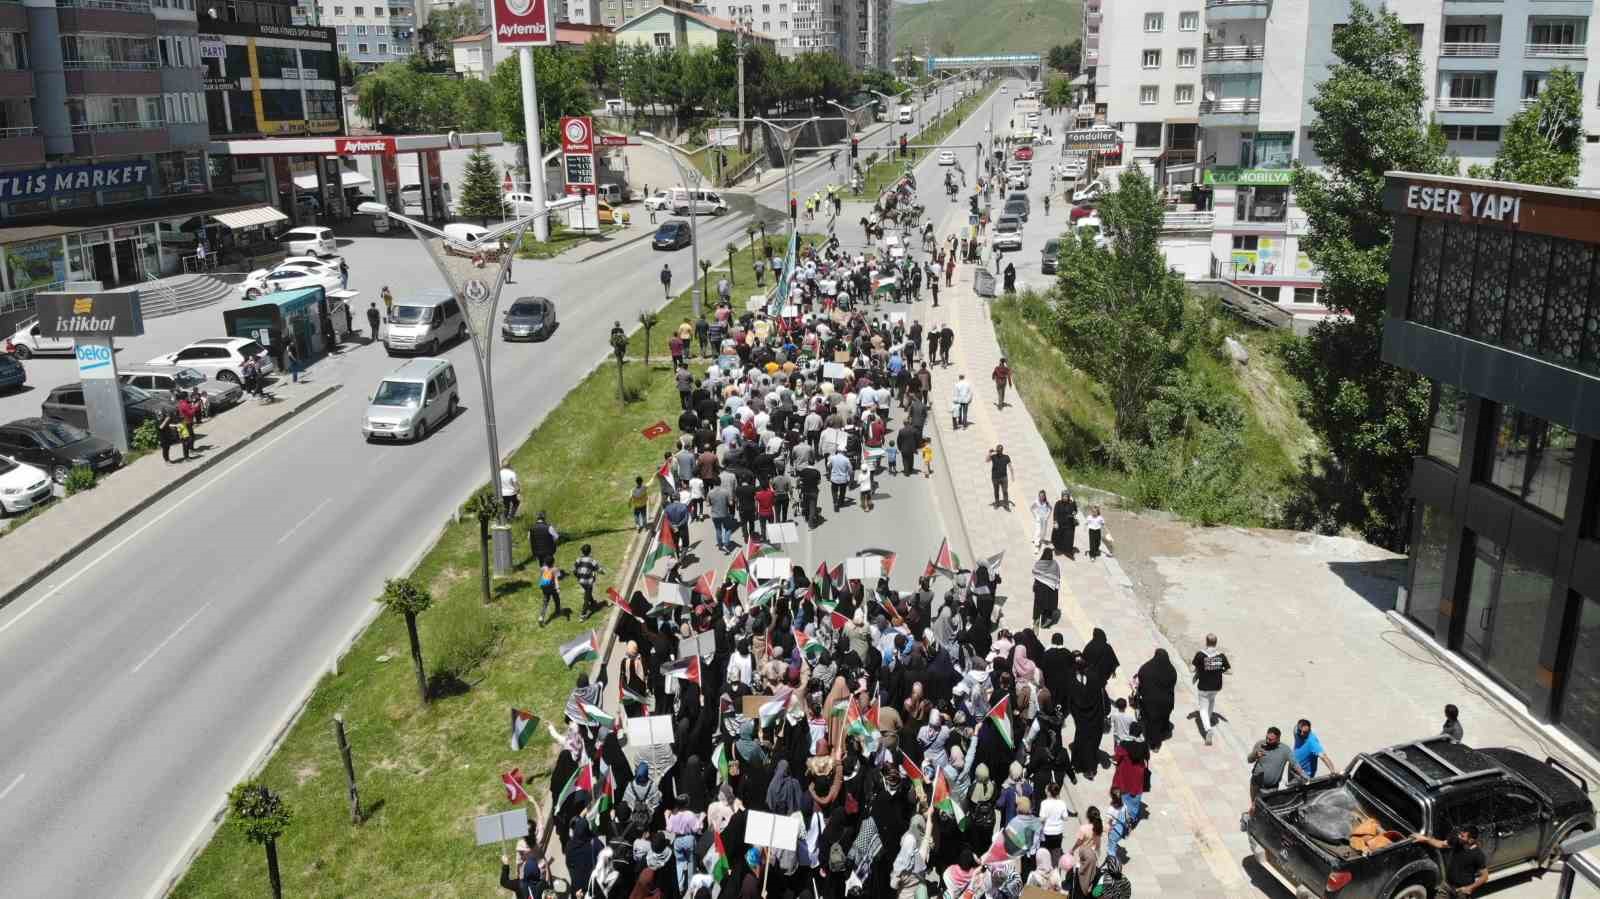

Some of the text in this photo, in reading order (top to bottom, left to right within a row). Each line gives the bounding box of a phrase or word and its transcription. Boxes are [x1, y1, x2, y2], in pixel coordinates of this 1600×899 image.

[499, 23, 545, 37] Aytemiz
[344, 140, 387, 153] Aytemiz
[54, 165, 147, 192] MARKET
[1407, 185, 1519, 223] ESER YAPI
[56, 315, 116, 332] istikbal
[78, 345, 110, 361] beko
